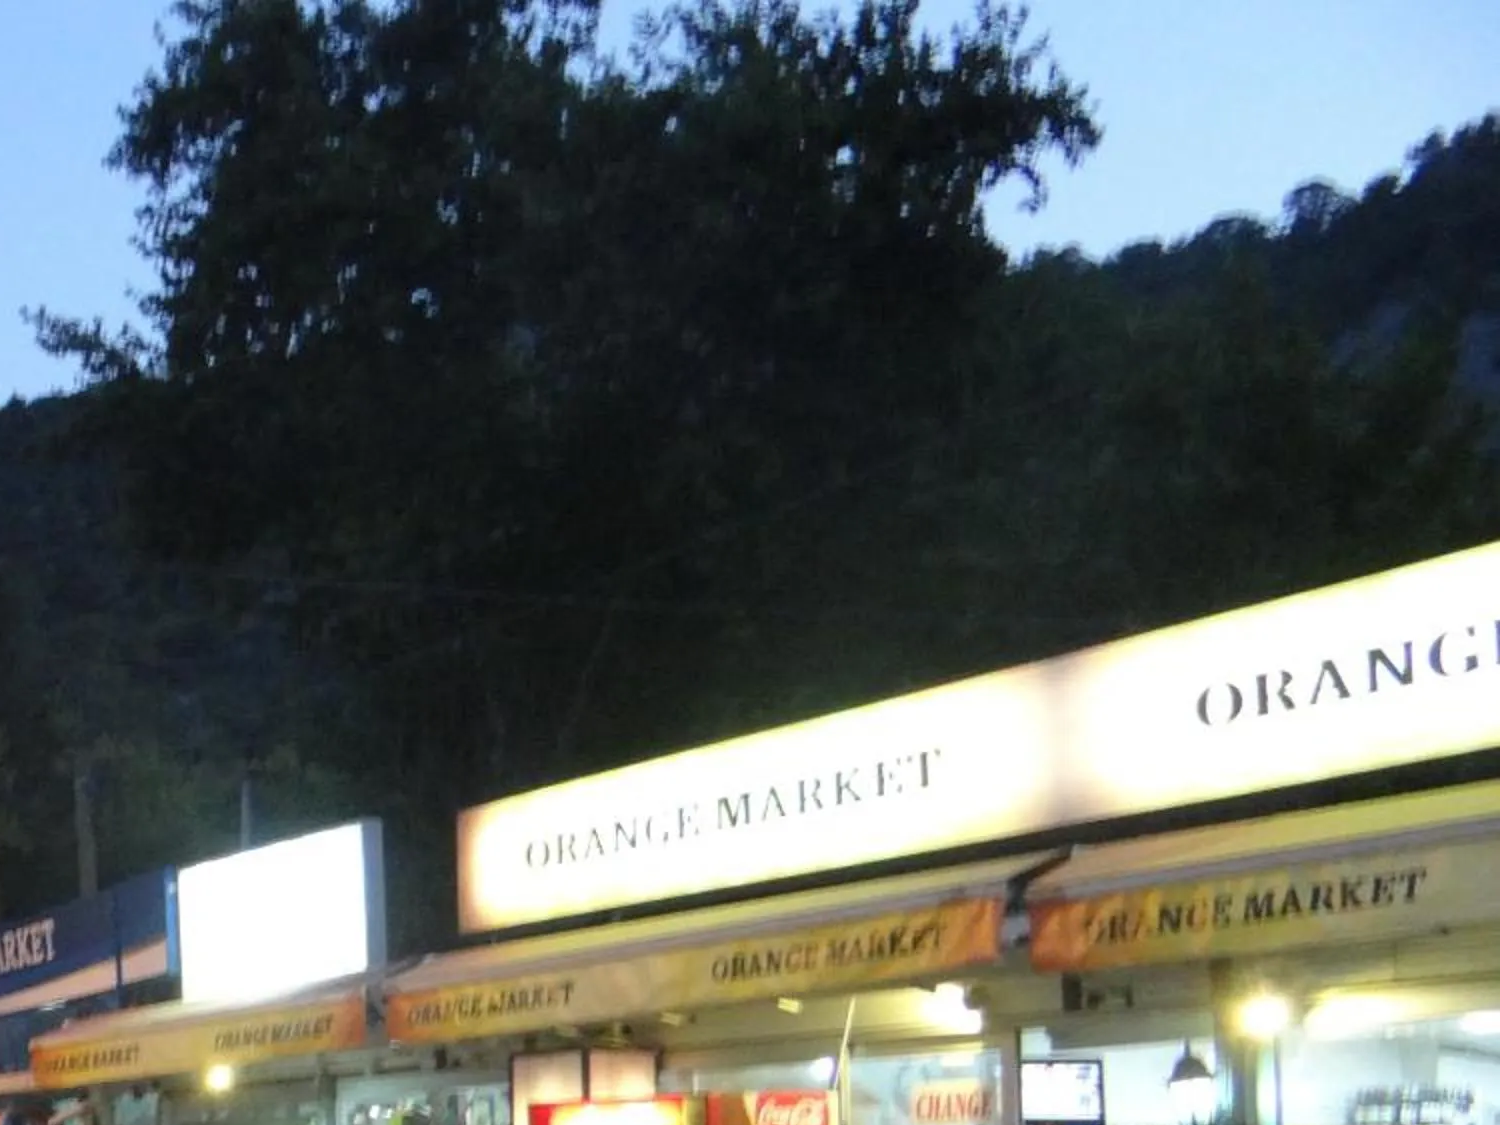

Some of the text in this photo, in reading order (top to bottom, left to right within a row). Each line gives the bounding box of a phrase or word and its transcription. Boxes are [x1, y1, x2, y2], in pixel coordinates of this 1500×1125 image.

[1196, 618, 1500, 726] ORANG
[526, 747, 942, 868] ORANGE MARKET
[1242, 866, 1428, 927] MARKET
[711, 921, 948, 983] ORANGE MARKET
[915, 1089, 992, 1121] CHANGE
